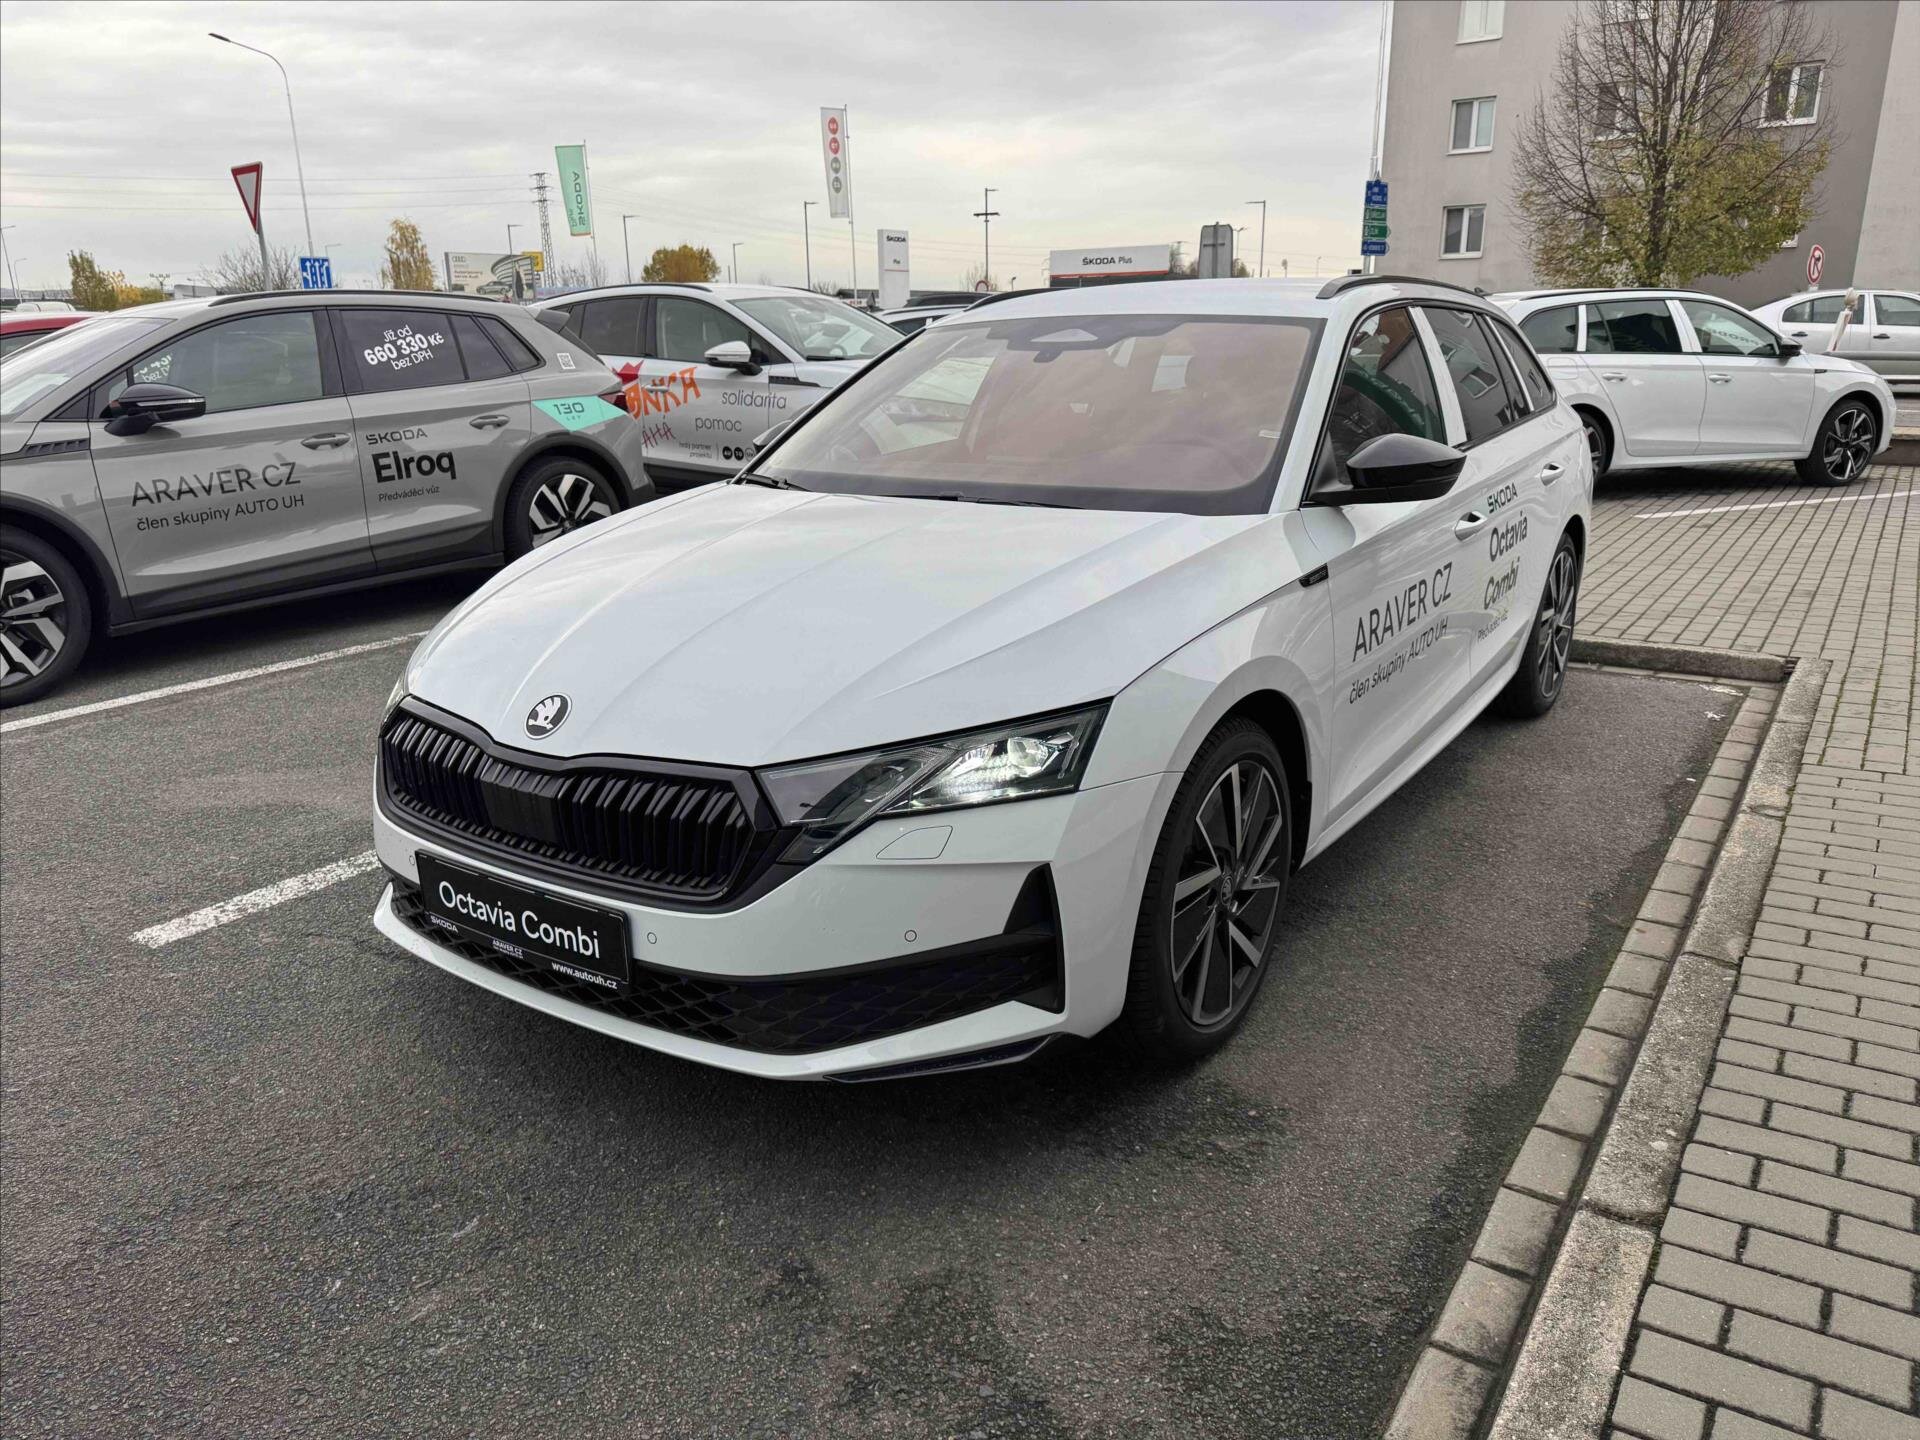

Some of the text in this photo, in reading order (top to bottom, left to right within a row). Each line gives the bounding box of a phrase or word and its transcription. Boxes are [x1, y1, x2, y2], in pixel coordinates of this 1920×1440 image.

[1082, 255, 1133, 266] ŠKODA Plus
[363, 332, 445, 365] 660 330 Kč
[383, 324, 412, 342] Již od
[391, 349, 434, 370] bez DPH
[553, 402, 585, 415] 130
[722, 389, 787, 409] solidarita
[695, 417, 742, 432] pomoc
[371, 451, 457, 483] Elroq
[132, 462, 301, 507] ARAVER CZ
[378, 484, 440, 502] Předváděcí vůz
[137, 494, 304, 531] člen skupiny AUTO UH
[1489, 510, 1528, 562] Octavia
[1484, 556, 1520, 610] Combi
[1352, 561, 1452, 663] ARAVER CZ
[1349, 615, 1449, 704] člen skupiny AUTO UH
[439, 881, 600, 959] Octavia Combi
[551, 961, 618, 990] www.autouh.cz
